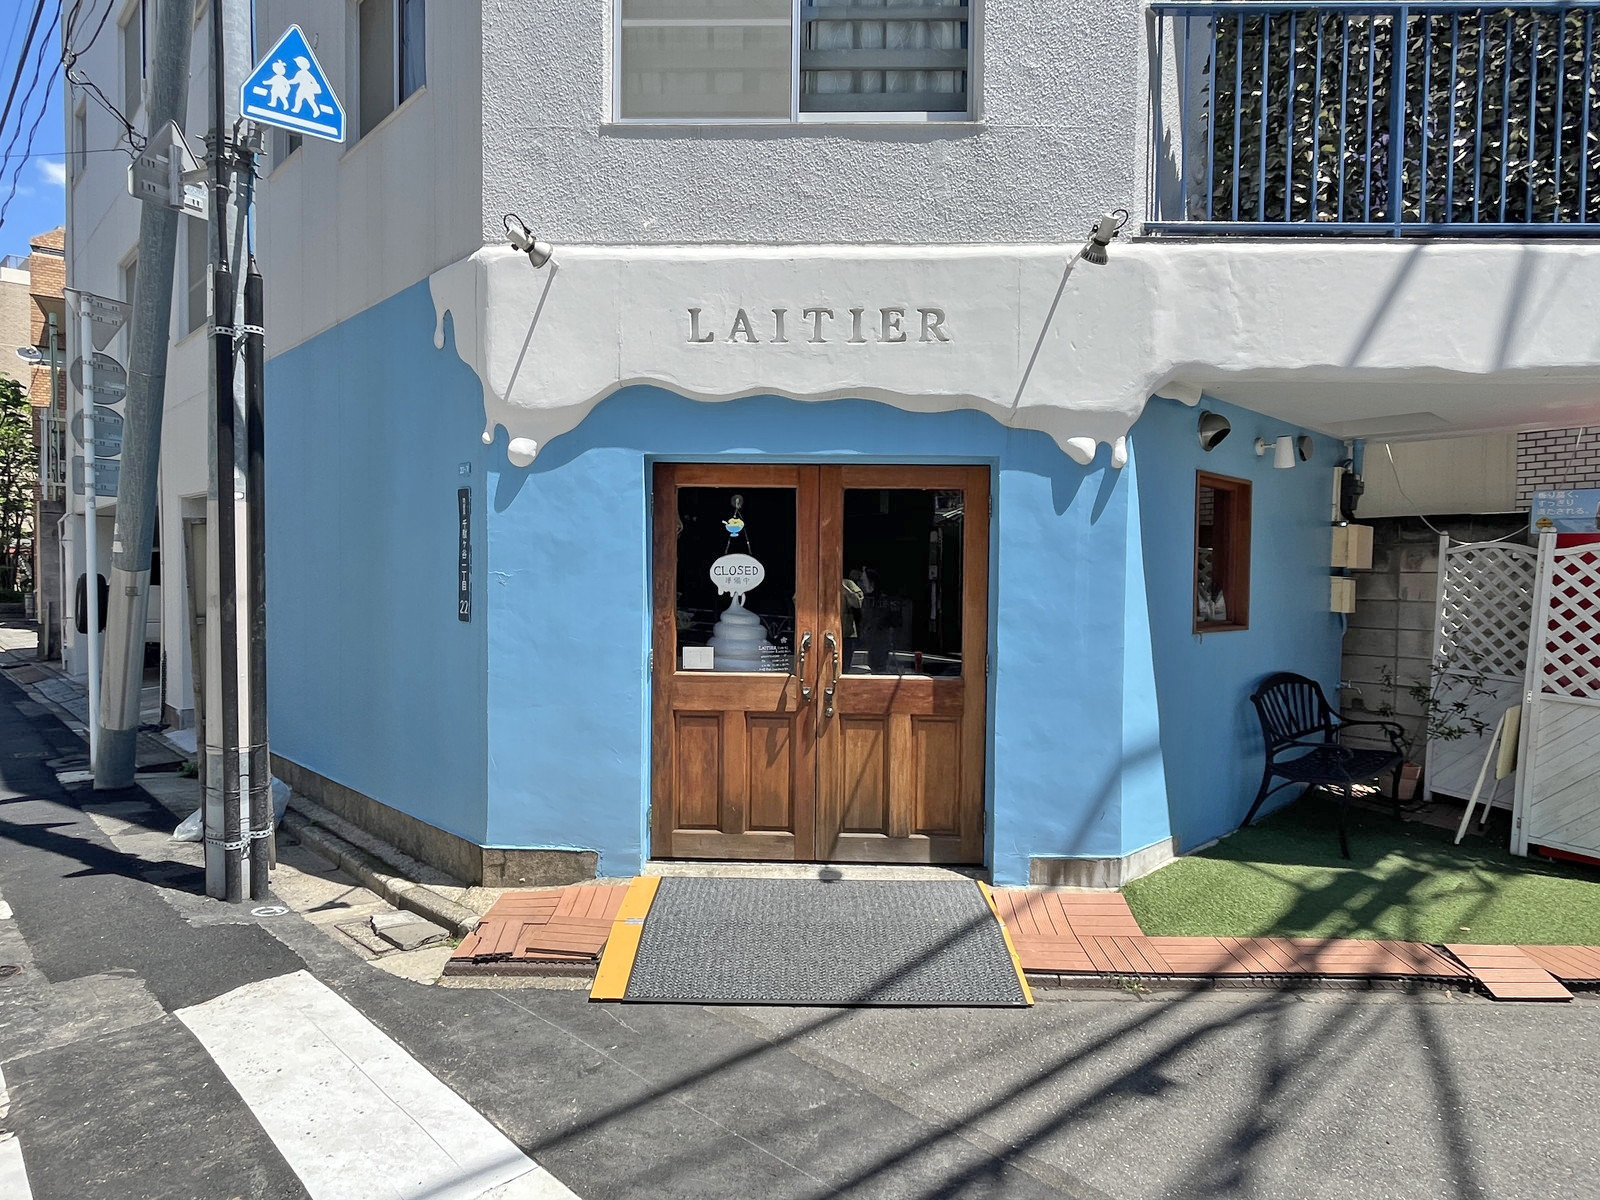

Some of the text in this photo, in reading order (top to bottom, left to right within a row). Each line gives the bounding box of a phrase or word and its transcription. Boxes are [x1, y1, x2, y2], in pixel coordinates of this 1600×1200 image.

[686, 307, 951, 344] LAITIER
[1538, 499, 1574, 507] すっきり
[713, 565, 759, 576] CLOSED
